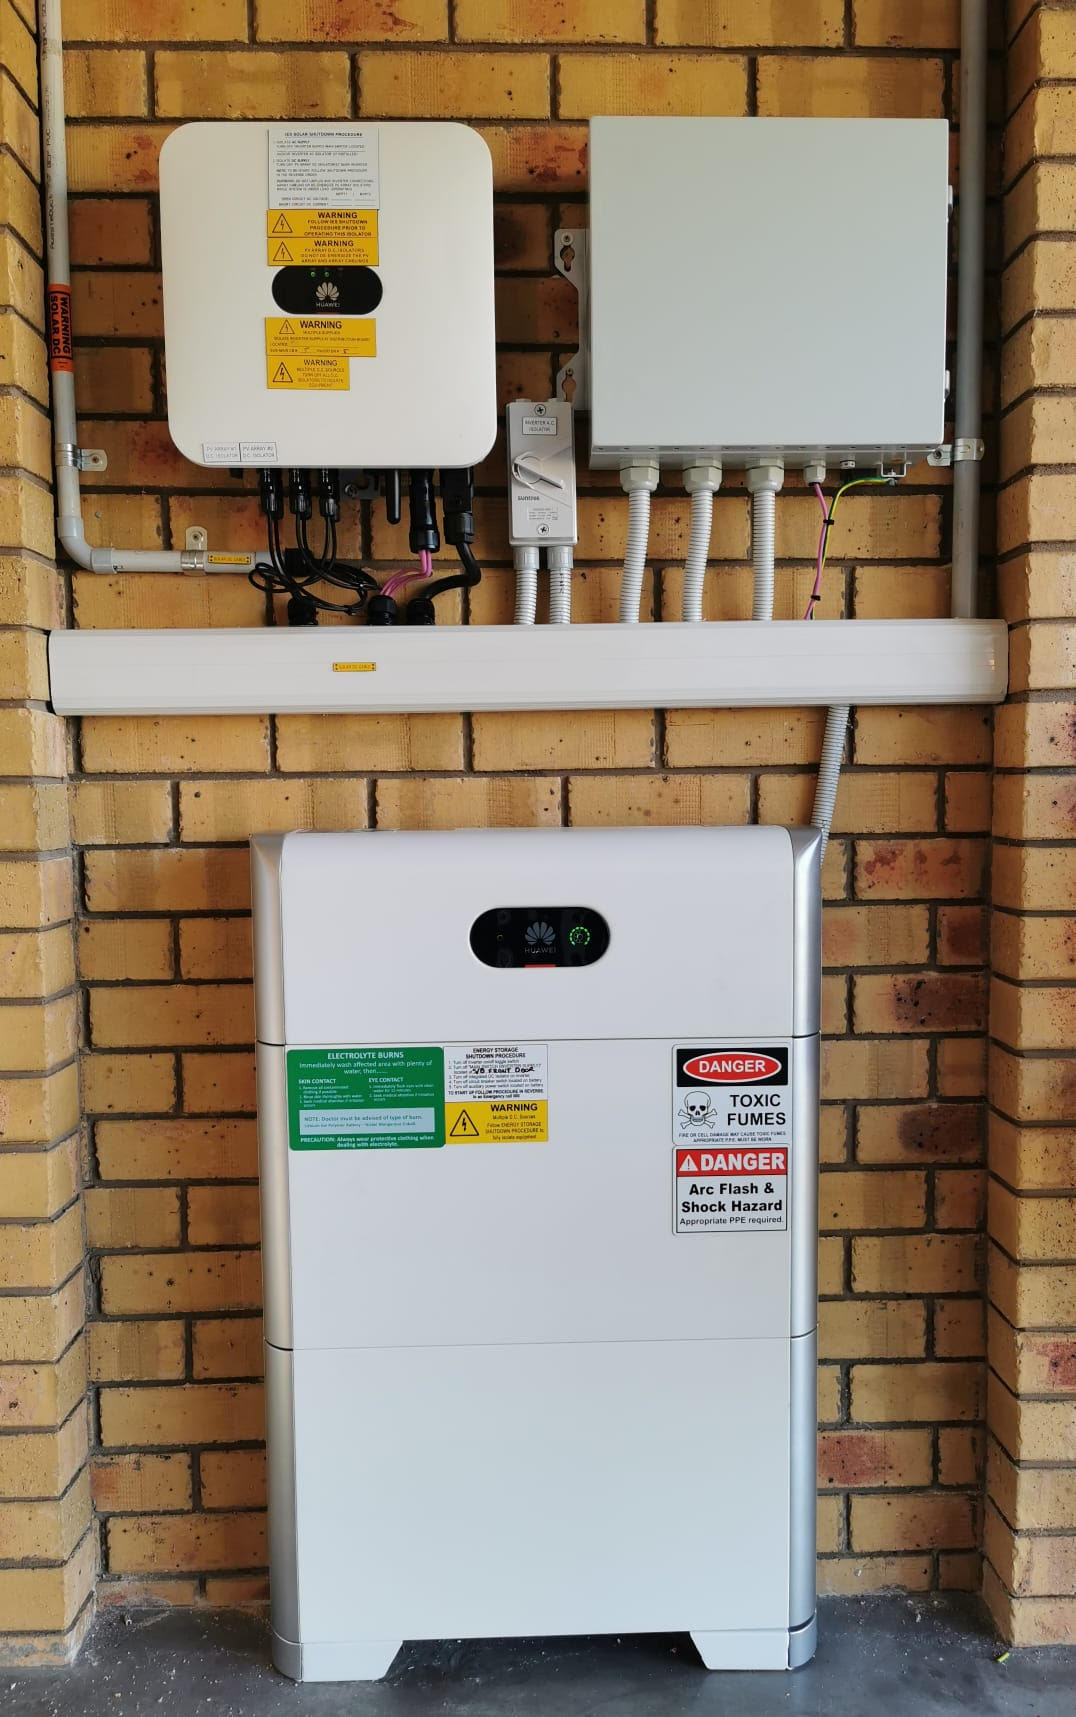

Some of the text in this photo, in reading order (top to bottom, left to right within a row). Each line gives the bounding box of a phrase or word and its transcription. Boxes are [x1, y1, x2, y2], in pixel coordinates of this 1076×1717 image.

[317, 211, 358, 219] WARNING
[51, 296, 60, 354] SOLAR DC
[60, 296, 71, 354] WARNING
[300, 320, 342, 329] WARNING
[698, 1060, 766, 1073] DANGER
[730, 1094, 781, 1107] TOXIC
[490, 1104, 538, 1112] WARNING
[727, 1112, 786, 1126] FUMES
[700, 1152, 786, 1171] DANGER
[689, 1182, 774, 1195] Arc Flash &
[681, 1200, 783, 1213] Shock Hazard
[680, 1218, 727, 1227] Appropriate
[748, 1216, 784, 1225] required.
